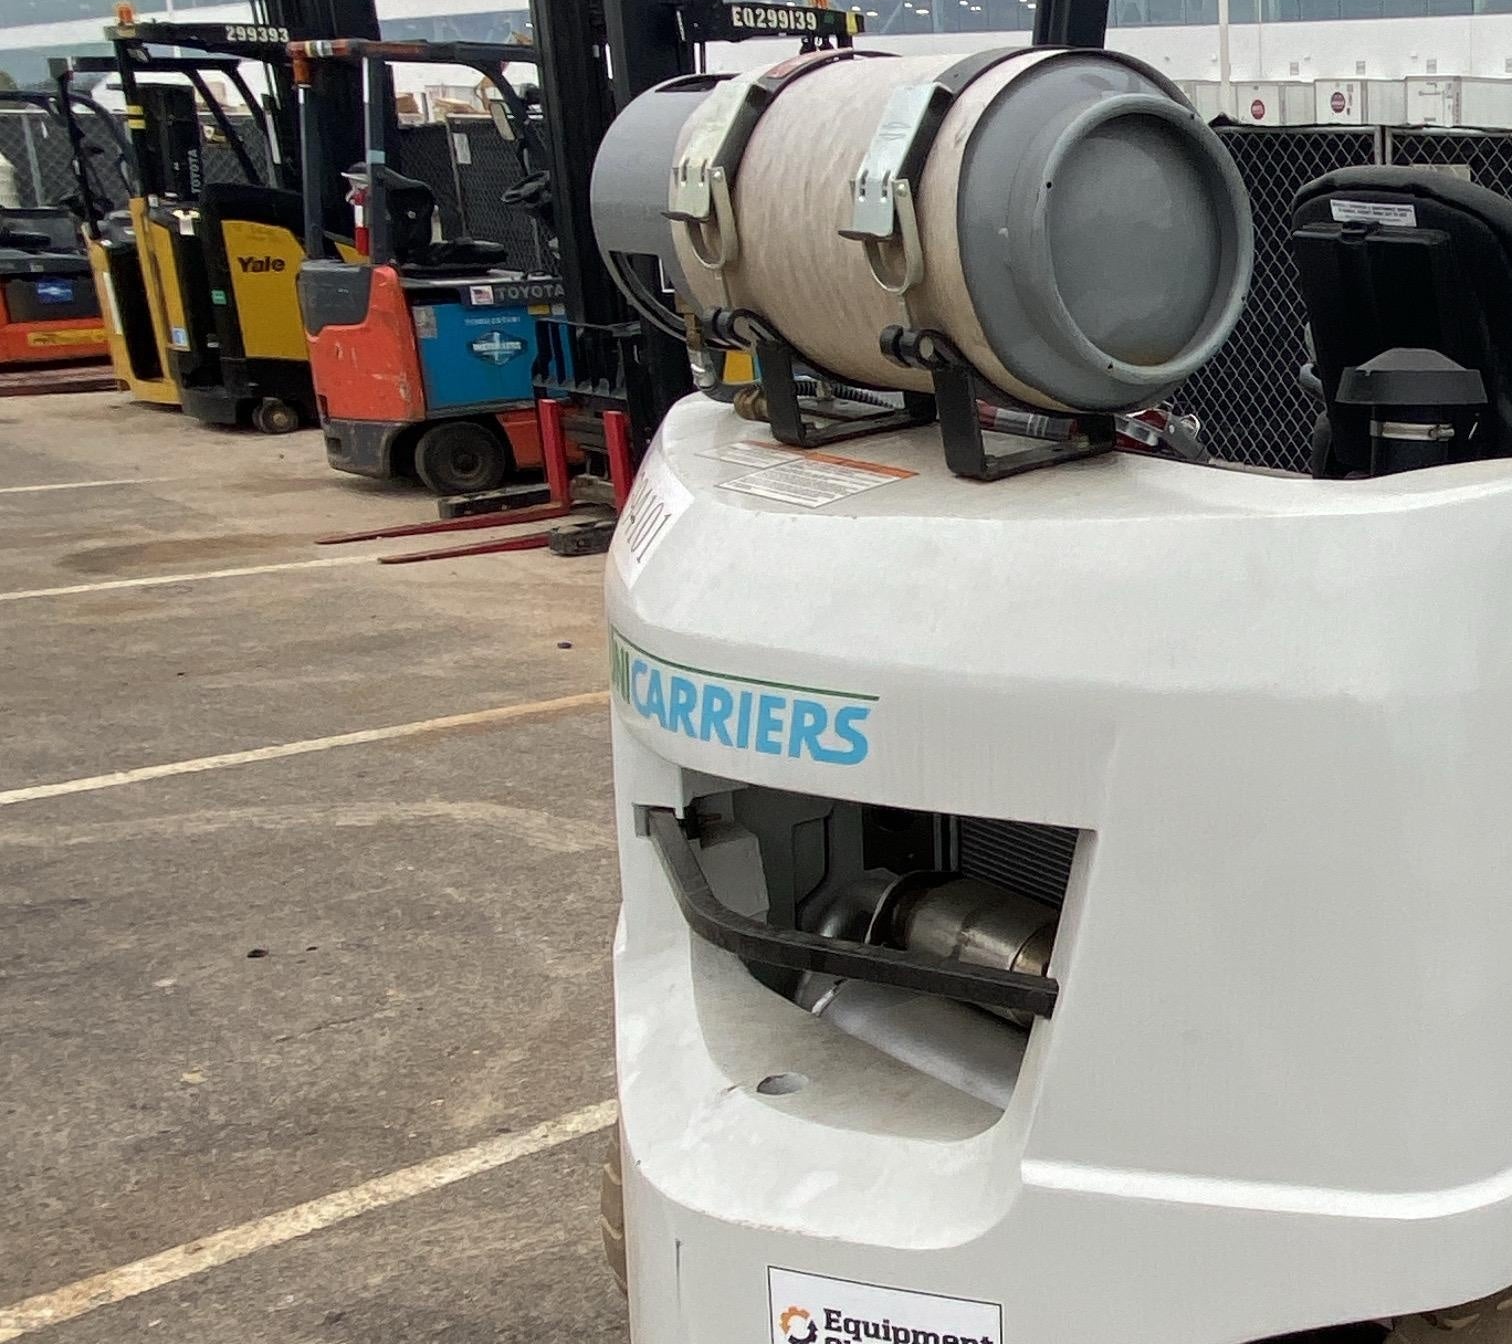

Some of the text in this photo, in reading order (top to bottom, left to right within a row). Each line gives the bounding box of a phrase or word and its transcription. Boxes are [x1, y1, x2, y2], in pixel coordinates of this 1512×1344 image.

[731, 6, 817, 31] EQ299139
[225, 25, 289, 43] 299393
[238, 256, 286, 273] Yale
[496, 284, 565, 300] TOYOTA
